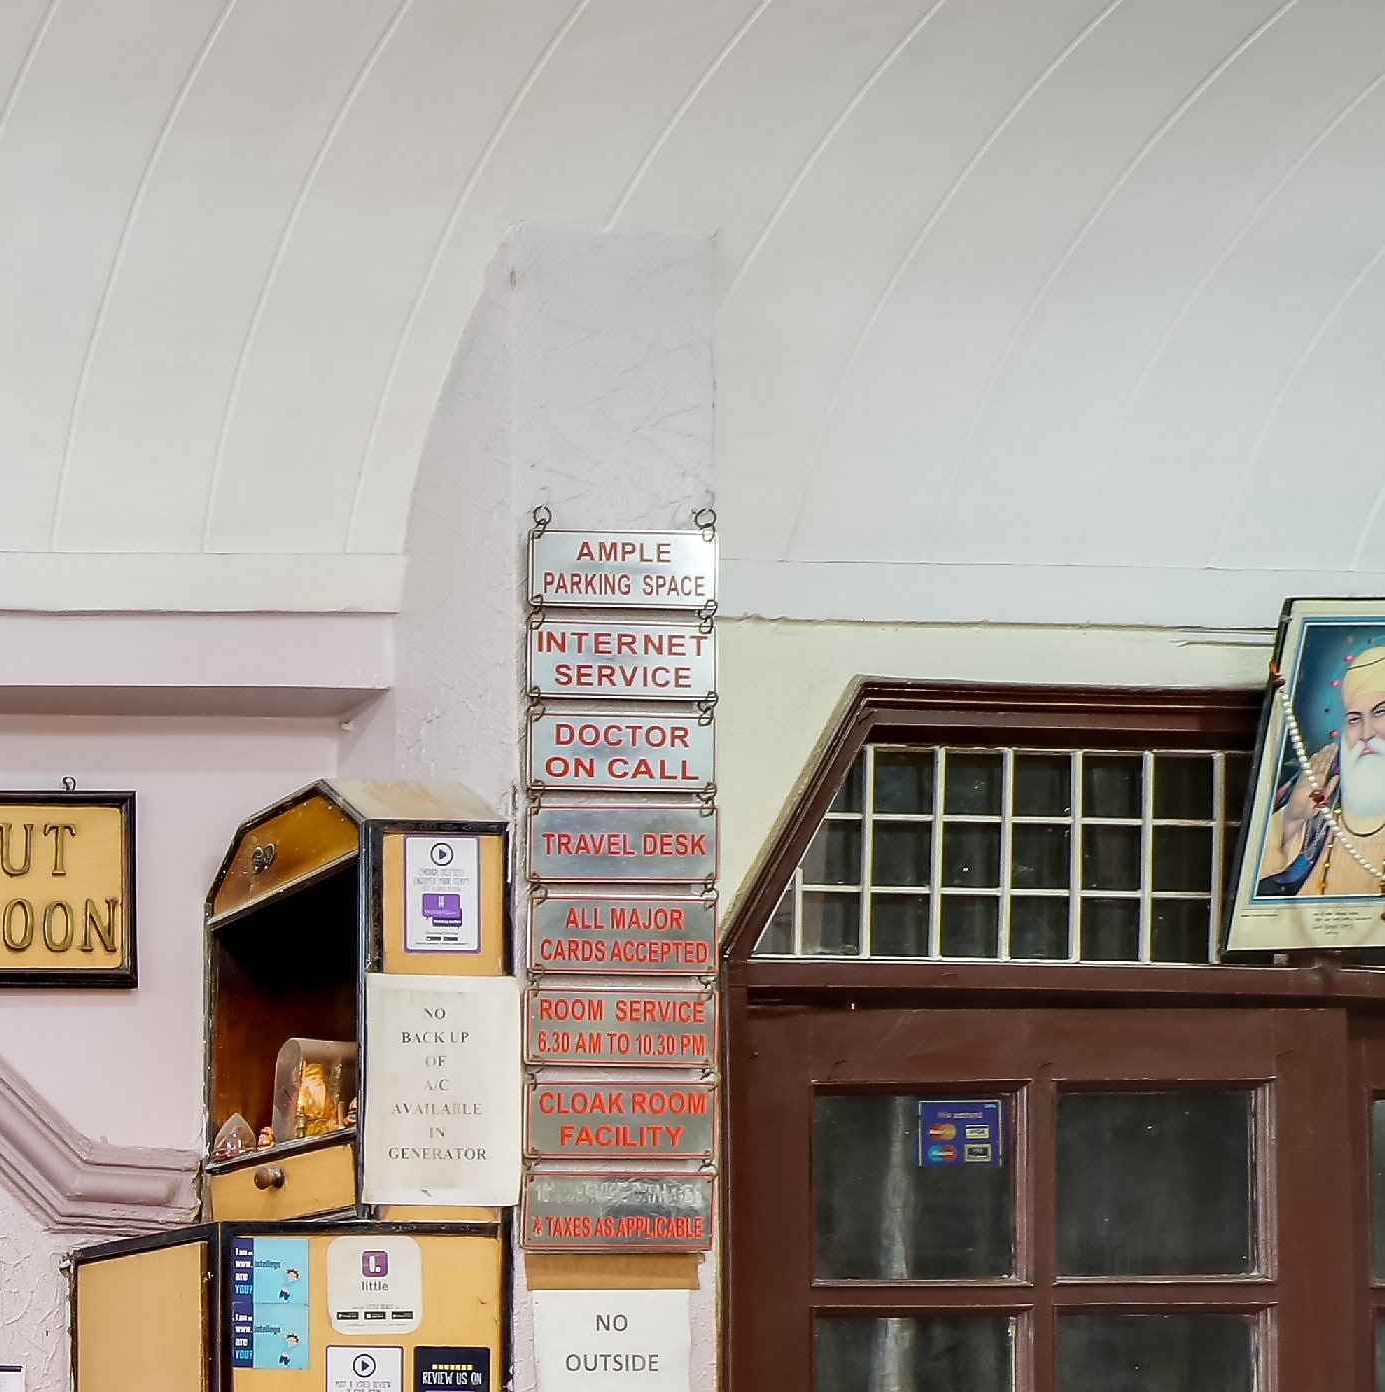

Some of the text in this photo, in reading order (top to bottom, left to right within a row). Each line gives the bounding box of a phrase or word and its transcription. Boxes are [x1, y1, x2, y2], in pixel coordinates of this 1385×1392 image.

[577, 542, 671, 563] AMPLE
[543, 571, 705, 597] PARKING SPACE
[537, 631, 707, 657] INTERNET
[554, 664, 692, 688] SERVICE
[555, 723, 690, 748] DOCTOR
[545, 757, 698, 780] ON CALL
[542, 833, 707, 855] TRAVEL DESK
[565, 907, 684, 930] ALL MAJOR
[541, 939, 708, 963] CARDS ACCEPTED
[424, 1008, 446, 1019] NO
[540, 998, 704, 1023] ROOM SERVICE
[402, 1032, 469, 1043] BACK UP
[538, 1031, 705, 1056] 6.30 AM TO 10.30 PM
[425, 1055, 446, 1067] OF
[424, 1079, 449, 1090] A/C
[392, 1103, 482, 1115] AVAILABLE
[539, 1092, 707, 1114] CLOAK ROOM
[429, 1127, 445, 1137] IN
[560, 1125, 684, 1147] FACILITY
[389, 1148, 486, 1160] GENERATOR
[546, 1216, 703, 1238] TAXES AS APPLICABLE
[362, 1281, 388, 1291] little
[596, 1315, 628, 1331] NO
[566, 1354, 659, 1372] OUTSIDE
[423, 1372, 482, 1385] REVIEW US ON
